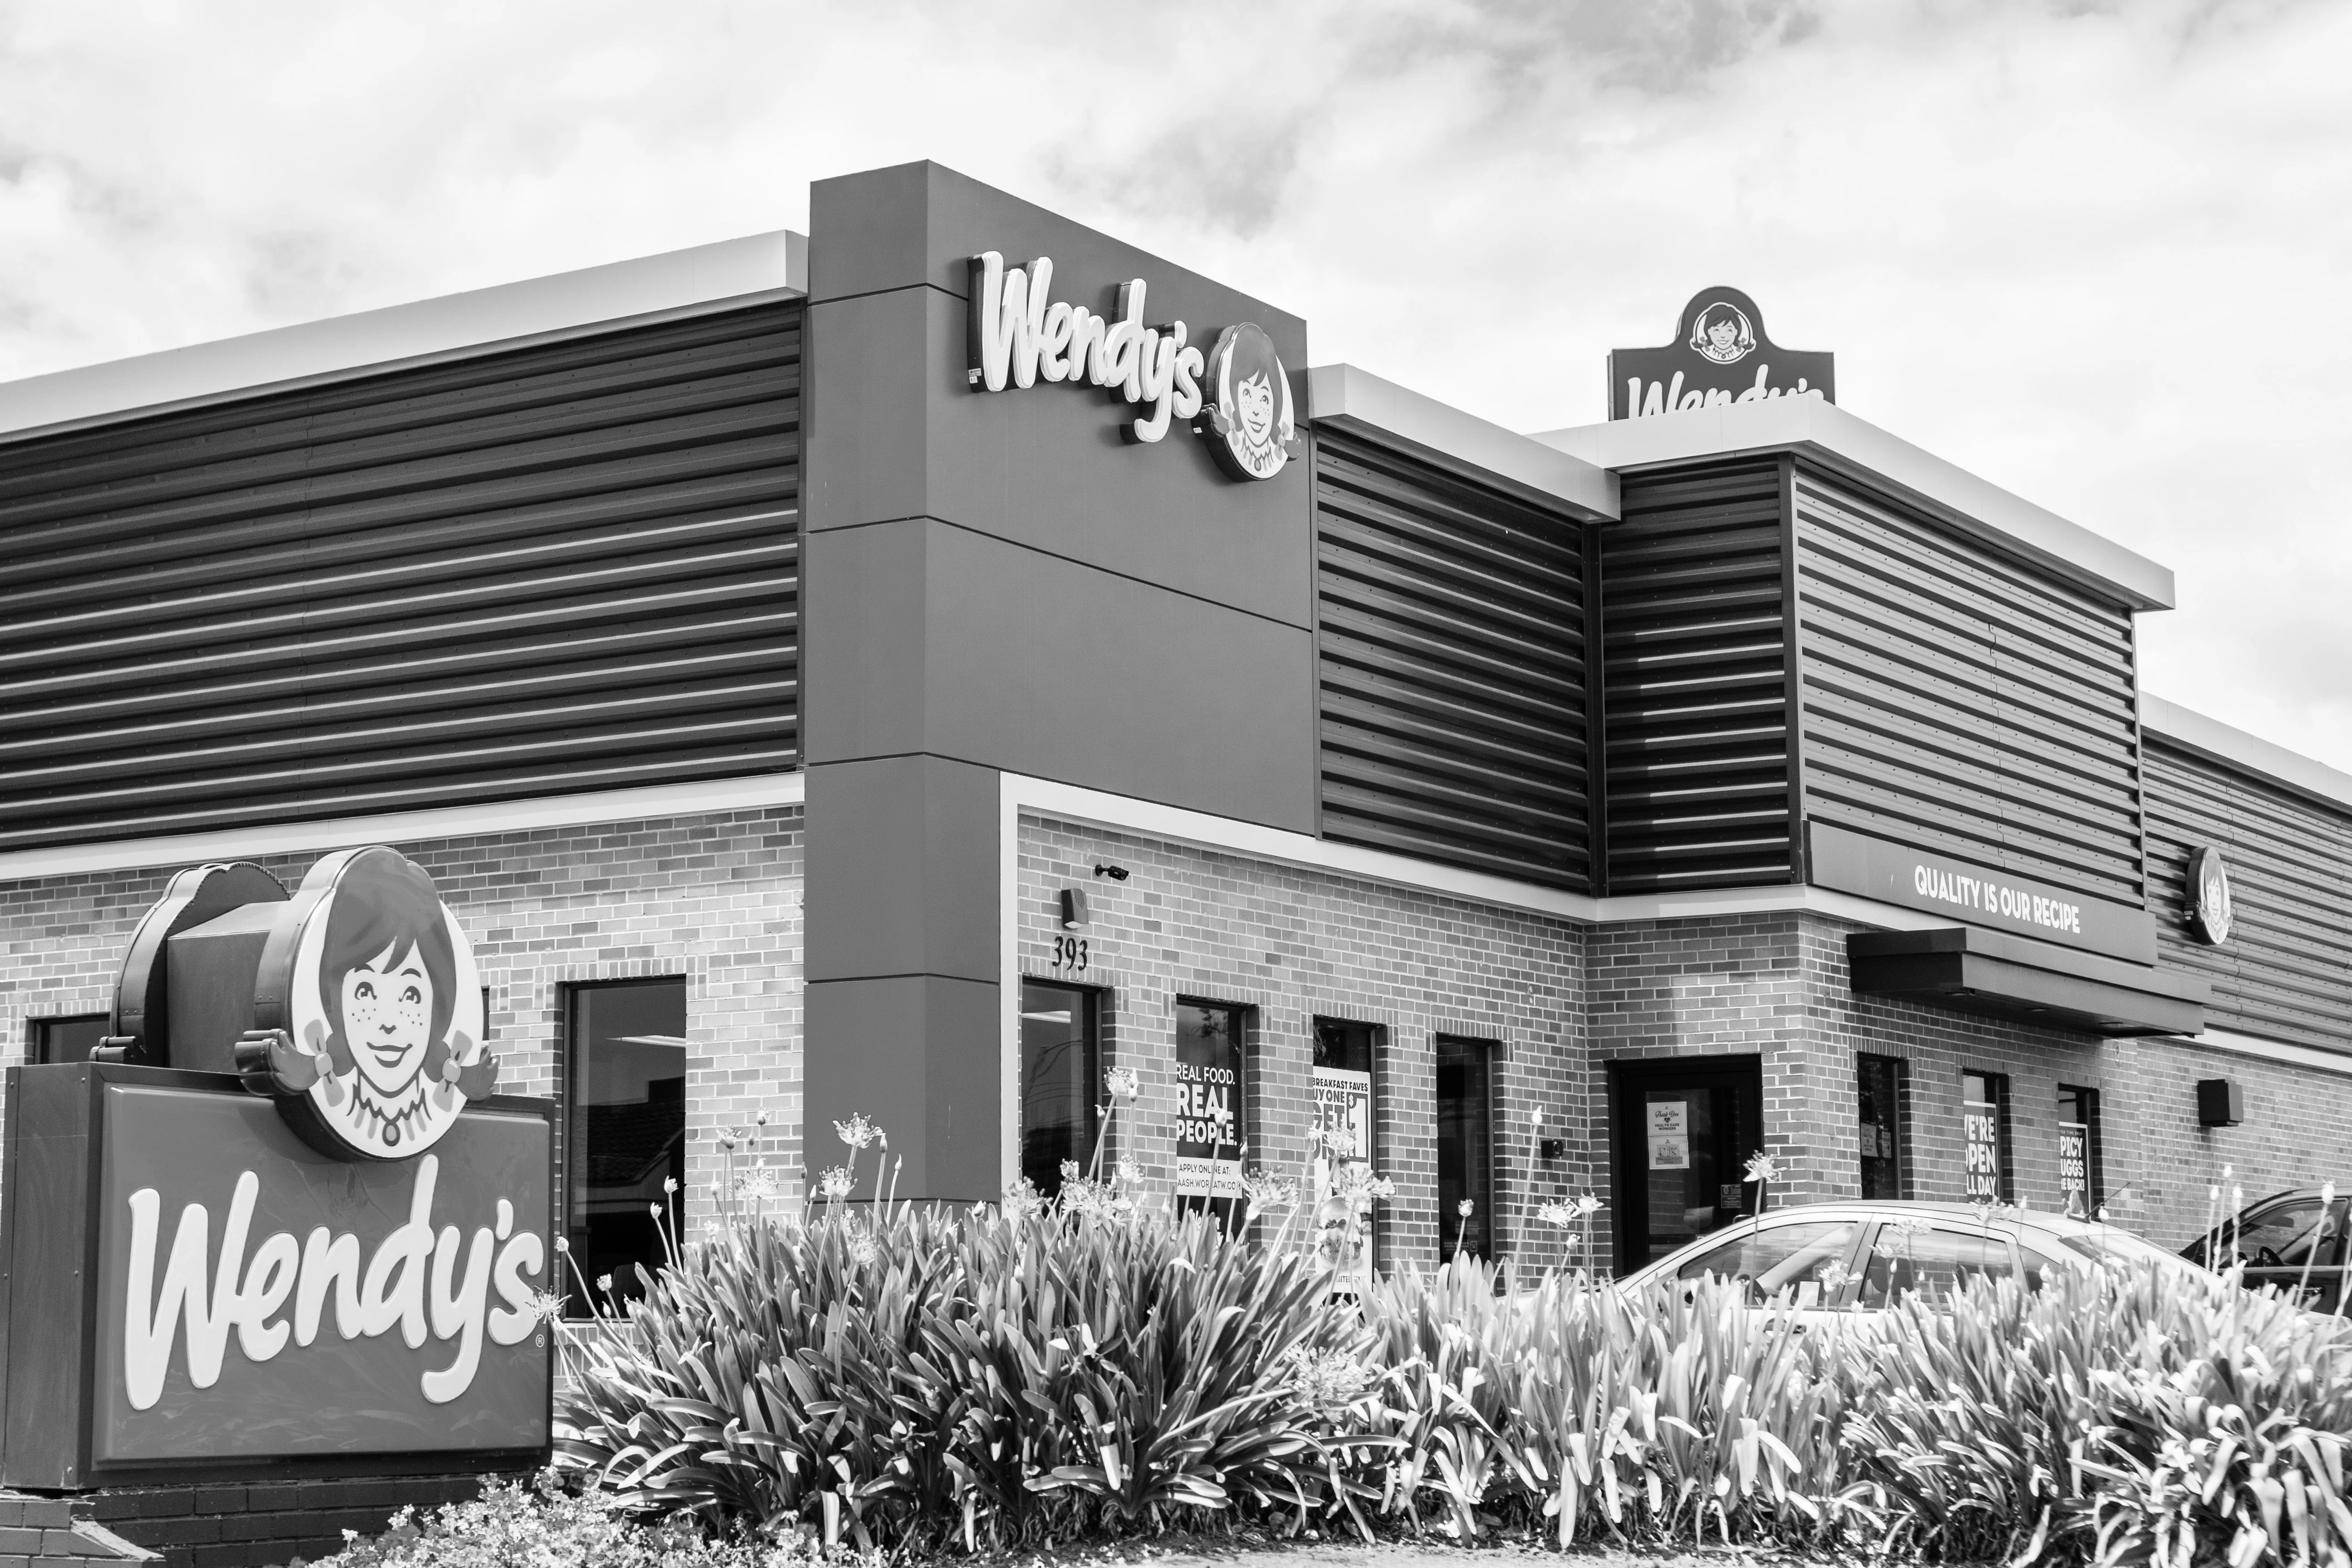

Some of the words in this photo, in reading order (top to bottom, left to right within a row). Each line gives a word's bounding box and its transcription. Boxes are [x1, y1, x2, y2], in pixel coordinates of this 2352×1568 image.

[982, 251, 1204, 443] Wendy's
[1914, 865, 1980, 908] QUALITY
[1984, 882, 1998, 913] IS
[2000, 887, 2031, 921] OUR
[2033, 895, 2080, 934] RECIPE
[1052, 936, 1088, 971] 393
[1176, 1064, 1201, 1081] REAL
[1204, 1066, 1236, 1085] FOOD.
[1312, 1077, 1347, 1090] BREAKFAST
[1349, 1081, 1368, 1092] FAVES
[1176, 1082, 1234, 1120] REAL
[1313, 1088, 1325, 1100] UY
[1326, 1089, 1345, 1103] ONE
[1176, 1120, 1237, 1146] PEOPLE.
[1964, 1114, 1995, 1142] E'RE
[1965, 1143, 1996, 1173] PEN
[2060, 1135, 2083, 1158] PICY
[1179, 1164, 1196, 1173] APPLY
[1199, 1165, 1221, 1174] ONLINE
[1222, 1167, 1231, 1175] AT:
[2060, 1158, 2084, 1178] UGGS
[1177, 1179, 1241, 1190] AASH.WORATW.CO
[1966, 1174, 1977, 1195] LL
[1978, 1175, 1996, 1196] DAY
[2067, 1178, 2085, 1191] BACK!
[125, 1153, 543, 1411] Wendy's
